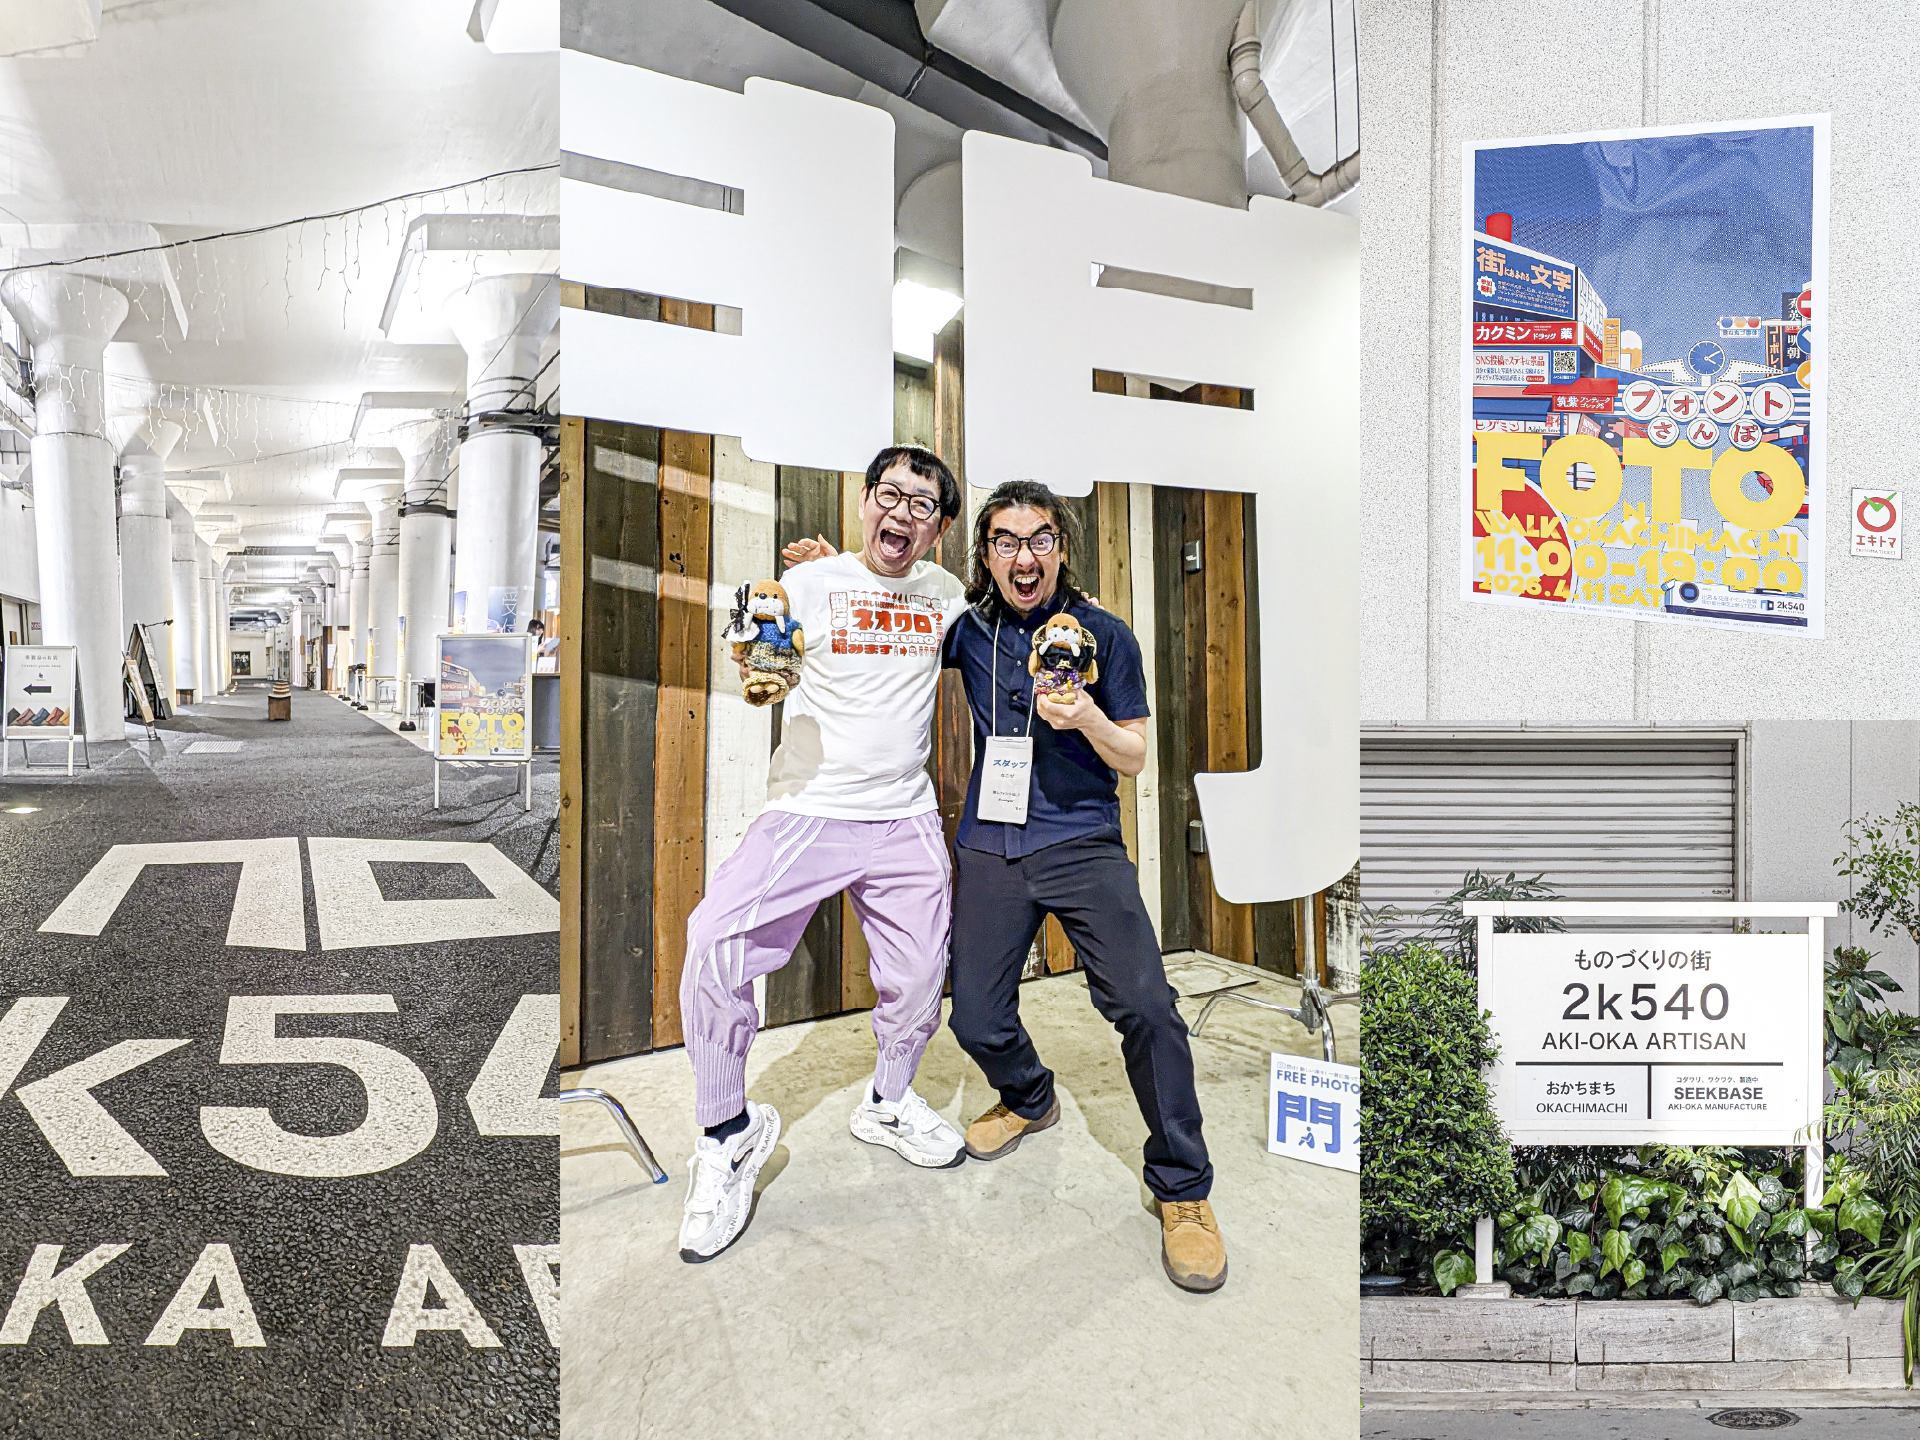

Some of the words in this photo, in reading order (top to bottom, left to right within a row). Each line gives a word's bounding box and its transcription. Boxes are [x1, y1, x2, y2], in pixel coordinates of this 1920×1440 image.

[1476, 245, 1572, 292] 街にあふれる文字
[1476, 325, 1531, 341] カクミン
[1533, 332, 1556, 340] ドラッグ
[1560, 328, 1573, 340] 薬
[1556, 395, 1579, 408] 筑紫
[1632, 388, 1783, 416] フォント
[1652, 418, 1758, 443] さんぽ
[1473, 432, 1806, 531] FOTO
[1474, 511, 1563, 540] WALK
[1566, 518, 1799, 559] OKACHIMACHI
[1856, 535, 1897, 548] エキトマ
[1610, 584, 1664, 609] SAT
[1777, 601, 1805, 611] 2k540
[849, 631, 936, 645] NEOKURO
[441, 712, 524, 734] FOTO
[992, 759, 1028, 769] スタッフ
[1574, 949, 1711, 972] ものづくりの街
[1562, 983, 1730, 1021] 2k540
[1541, 1032, 1639, 1050] AKI-OKA
[1646, 1032, 1747, 1050] ARTISAN
[1276, 1069, 1307, 1085] FREE
[1311, 1075, 1360, 1095] PHOTO
[1546, 1080, 1616, 1096] おかちまち
[1674, 1087, 1764, 1100] SEEKBASE
[1536, 1102, 1629, 1114] OKACHIMACHI
[1668, 1103, 1703, 1111] AKI-OKA
[1704, 1103, 1768, 1111] MANUFACTURE
[1276, 1091, 1342, 1154] 門
